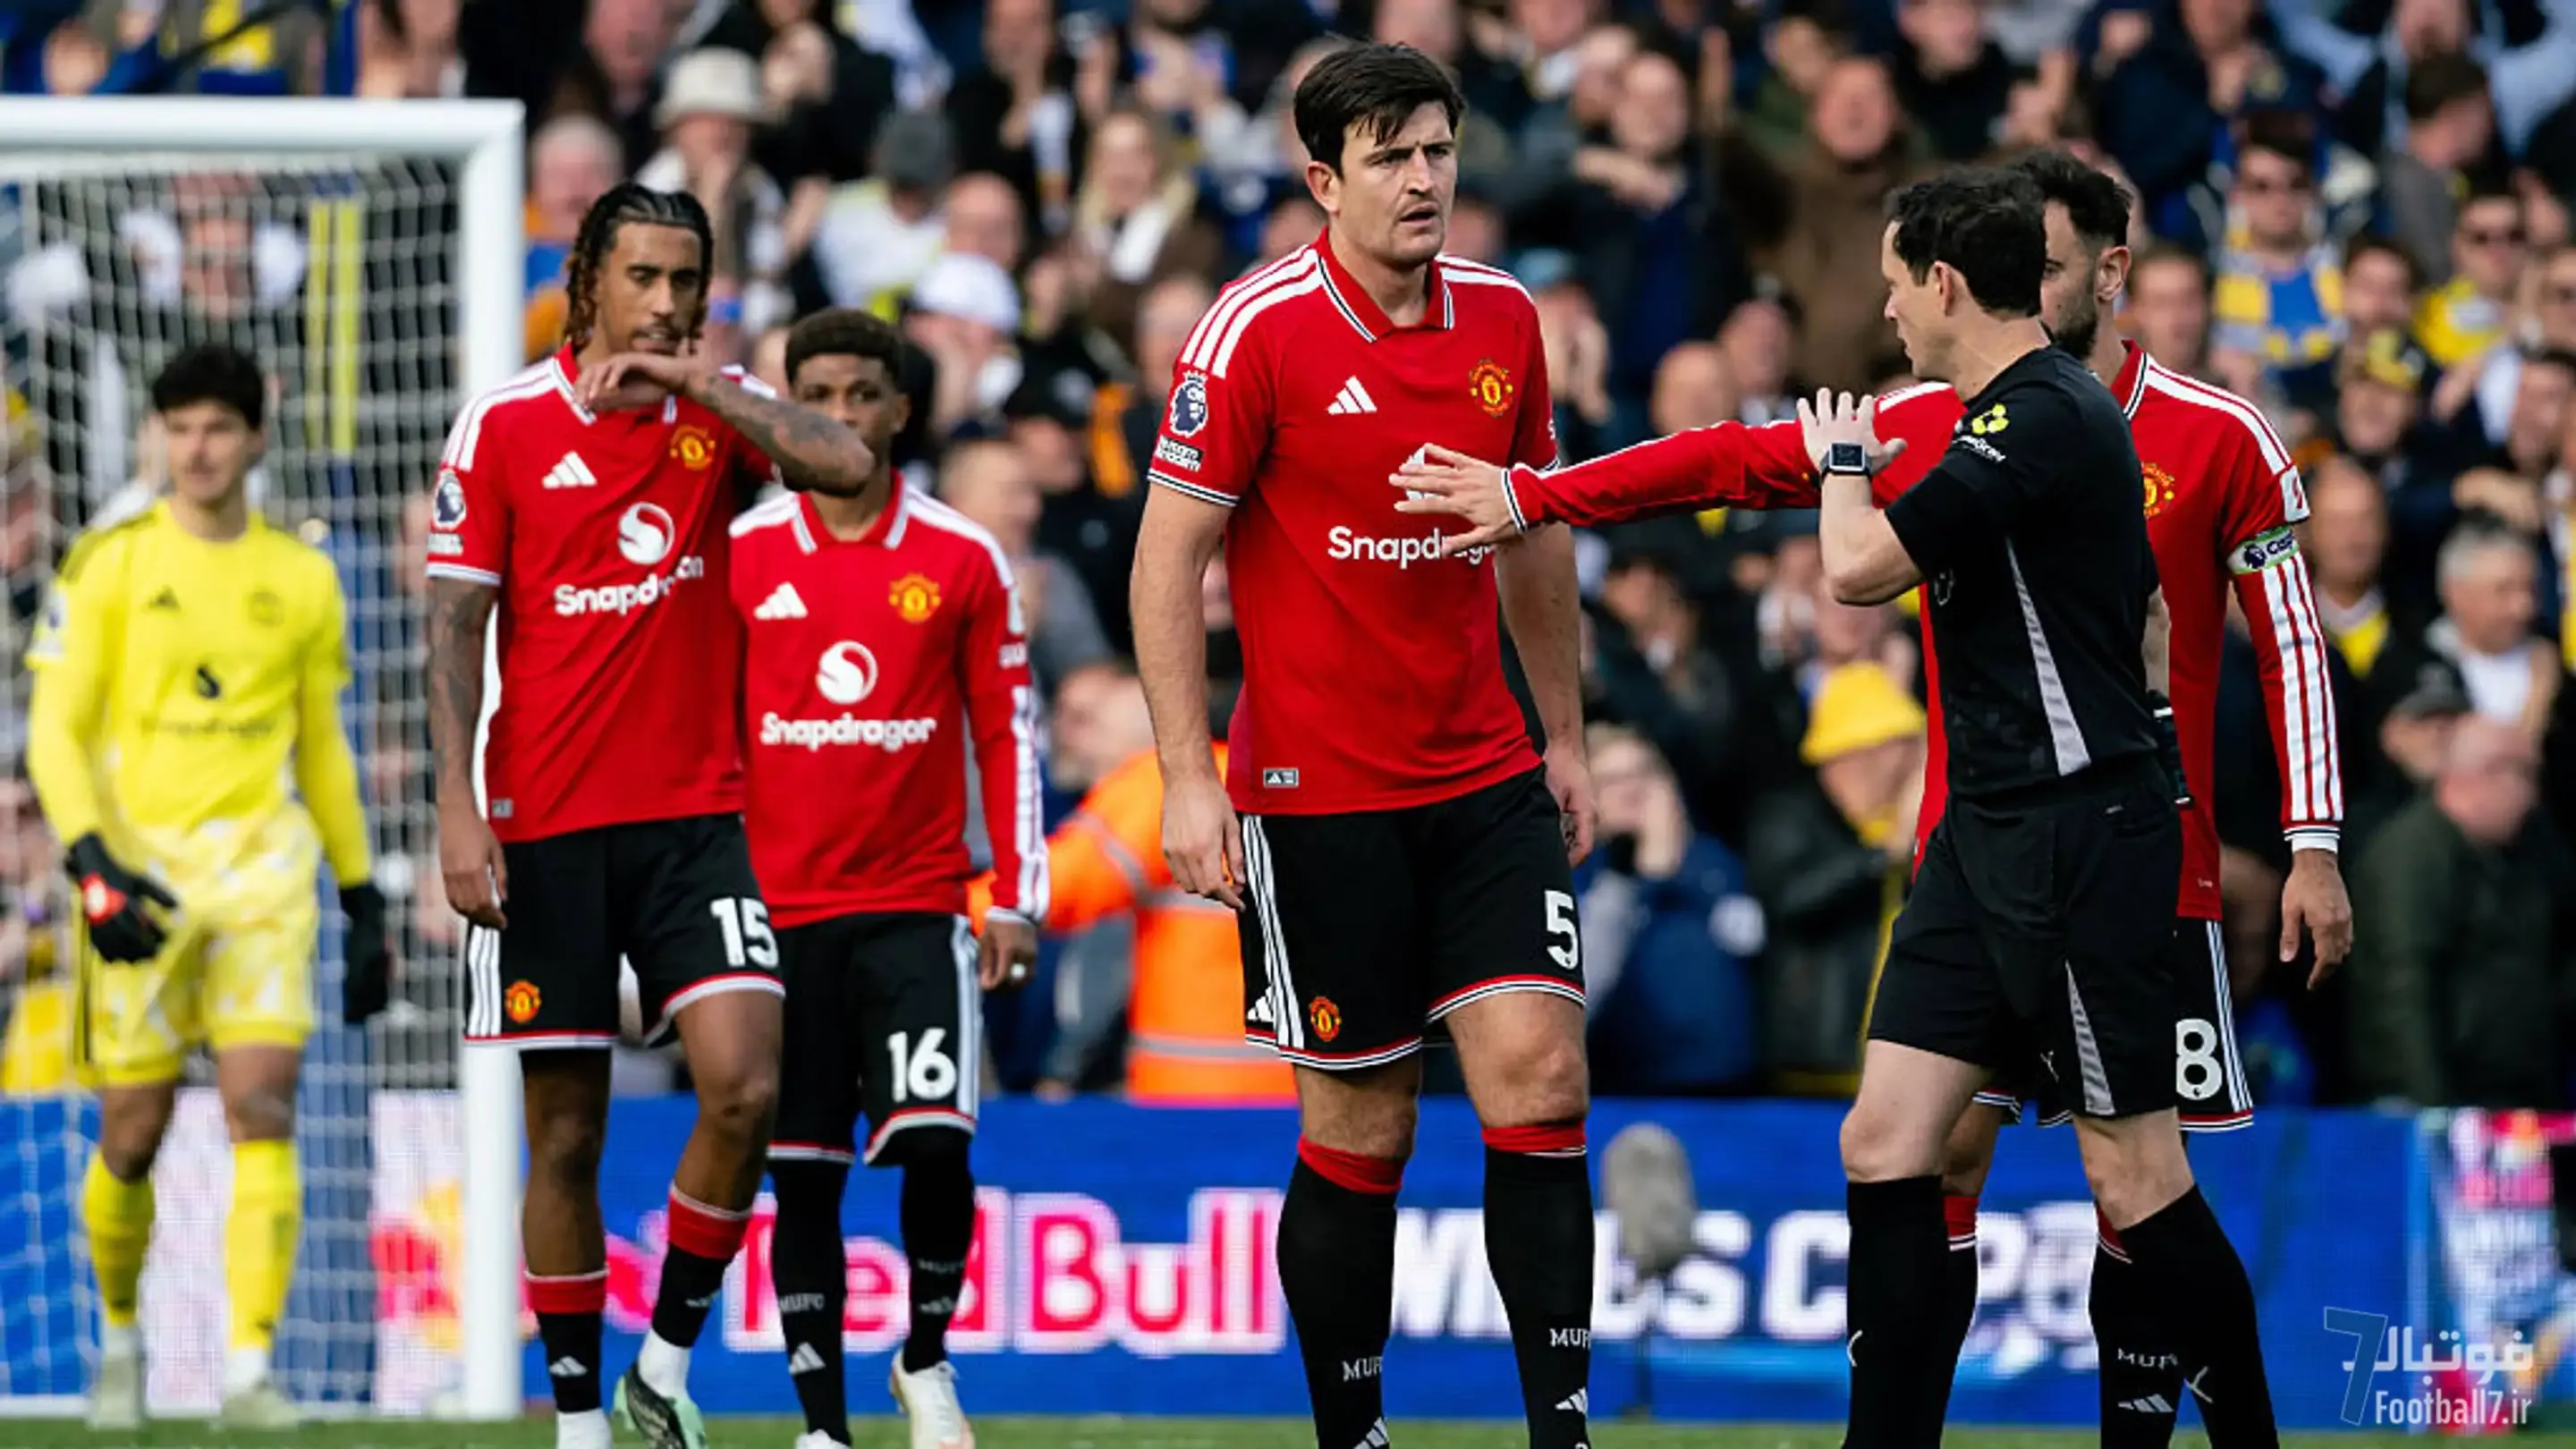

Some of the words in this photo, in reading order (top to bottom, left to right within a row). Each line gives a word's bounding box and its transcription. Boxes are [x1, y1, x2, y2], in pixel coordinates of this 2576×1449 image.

[711, 897, 780, 969] 15
[1544, 889, 1579, 970] 5
[887, 1028, 958, 1103] 16
[2175, 1018, 2223, 1101] 8
[1024, 1197, 1277, 1342] Bull
[1343, 1356, 1383, 1382] MUF
